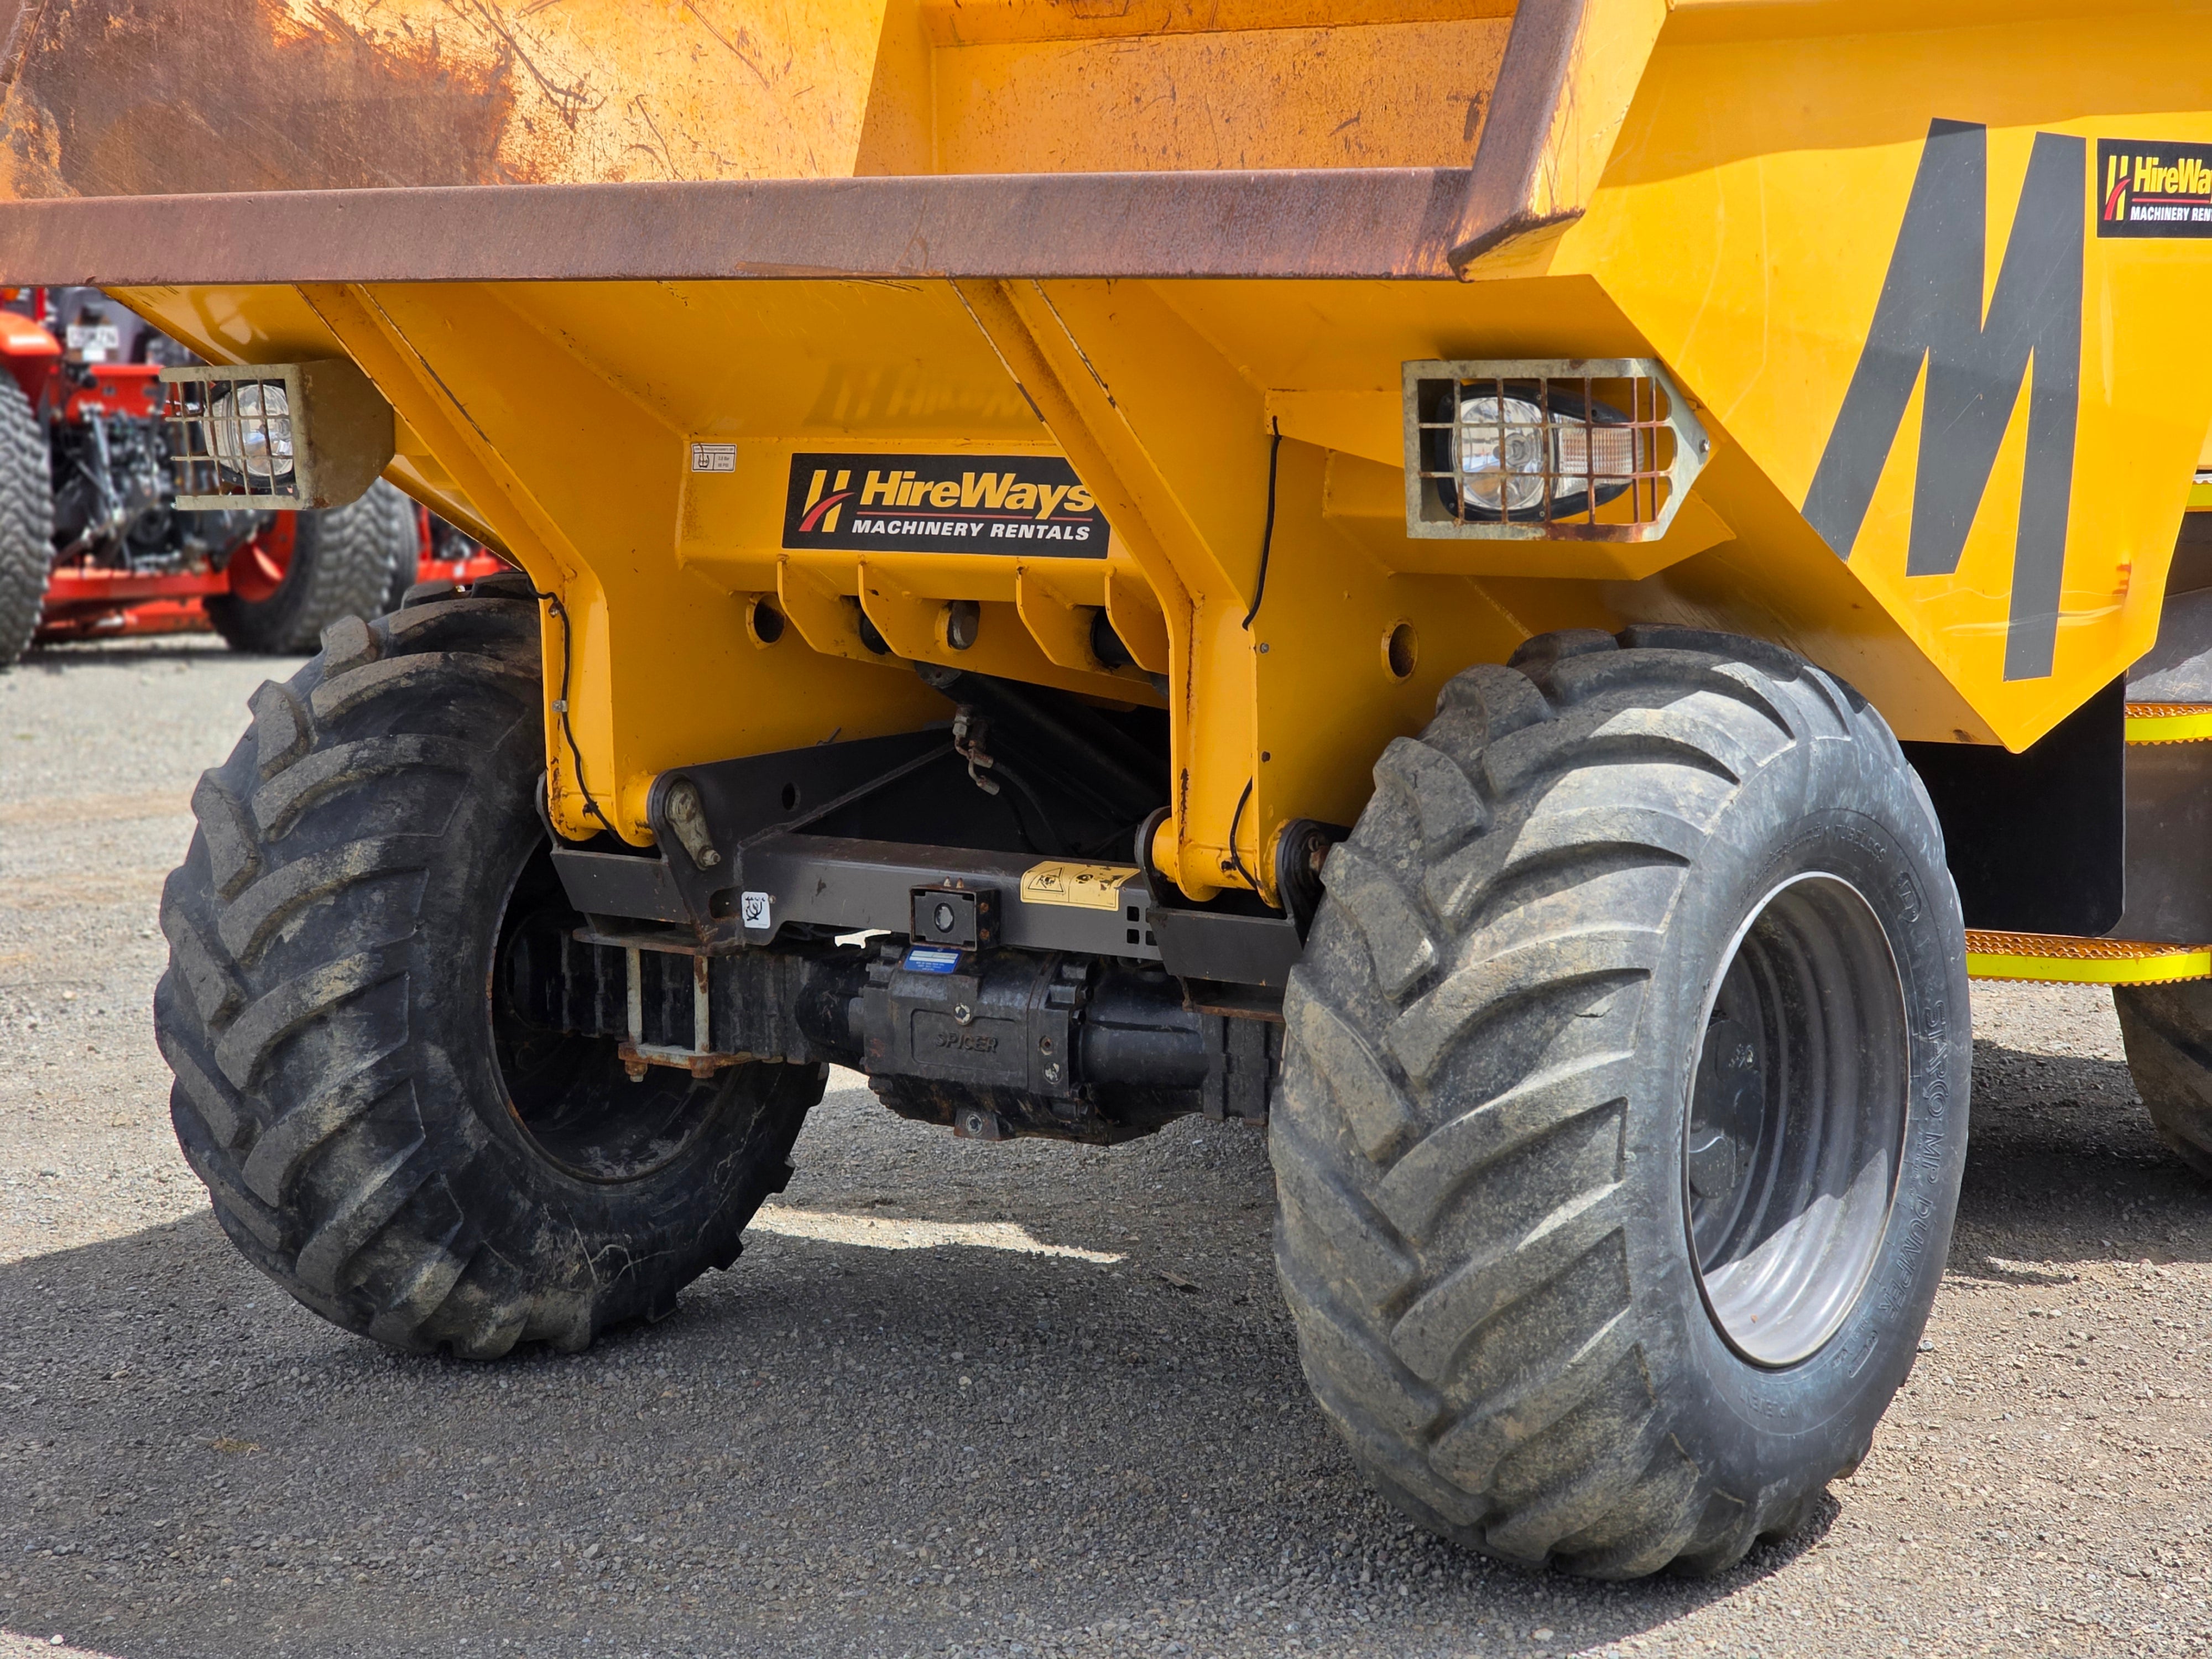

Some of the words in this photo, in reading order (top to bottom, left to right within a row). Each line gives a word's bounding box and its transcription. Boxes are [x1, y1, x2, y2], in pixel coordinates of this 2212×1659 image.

[2133, 156, 2212, 203] HireWa
[2130, 206, 2190, 221] MACHINERY
[2192, 207, 2212, 221] REN
[1801, 117, 2086, 681] M
[859, 470, 1095, 520] HireWays
[852, 519, 984, 537] MACHINERY
[990, 523, 1091, 541] RENTALS
[1835, 823, 1887, 863] TUBELESS
[936, 1032, 999, 1053] SPICER
[1923, 1000, 1950, 1118] STARCO
[1920, 1131, 1943, 1187] MP
[1879, 1196, 1933, 1321] DUMPER
